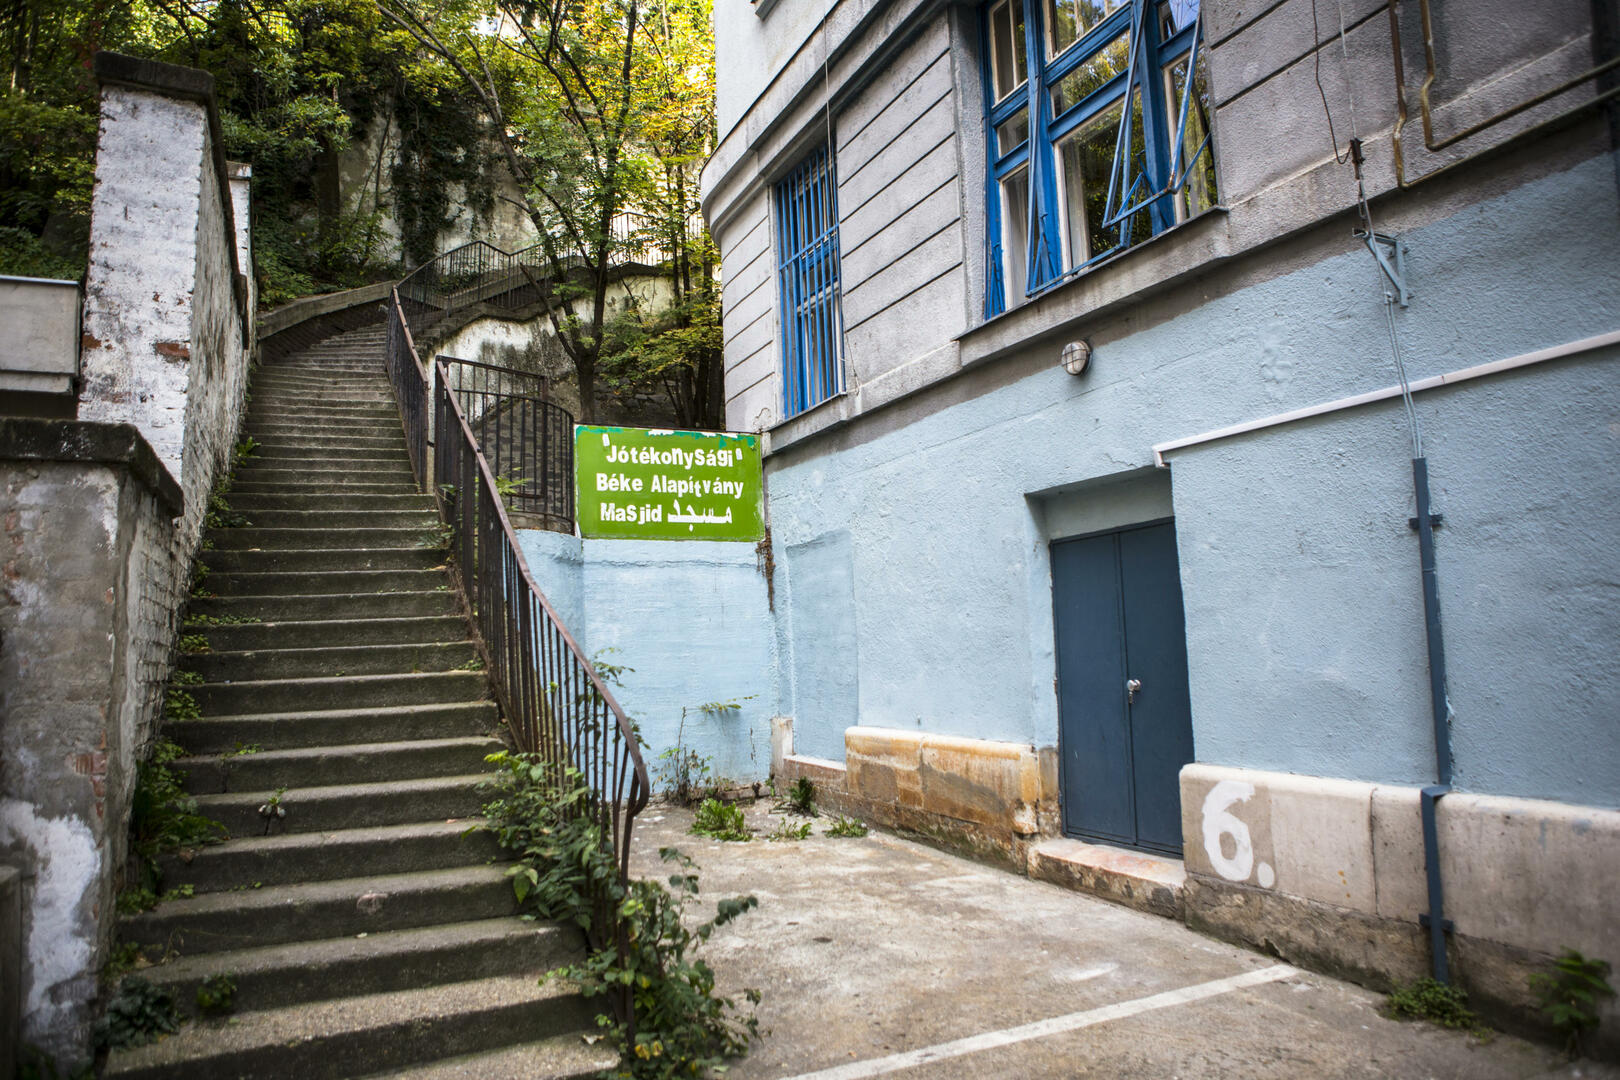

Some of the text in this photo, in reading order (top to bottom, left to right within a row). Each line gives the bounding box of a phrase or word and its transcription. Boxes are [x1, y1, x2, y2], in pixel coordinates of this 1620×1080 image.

[596, 472, 744, 499] Béke Alapítvány
[667, 499, 733, 532] مسجد
[1202, 780, 1275, 889] 6.
